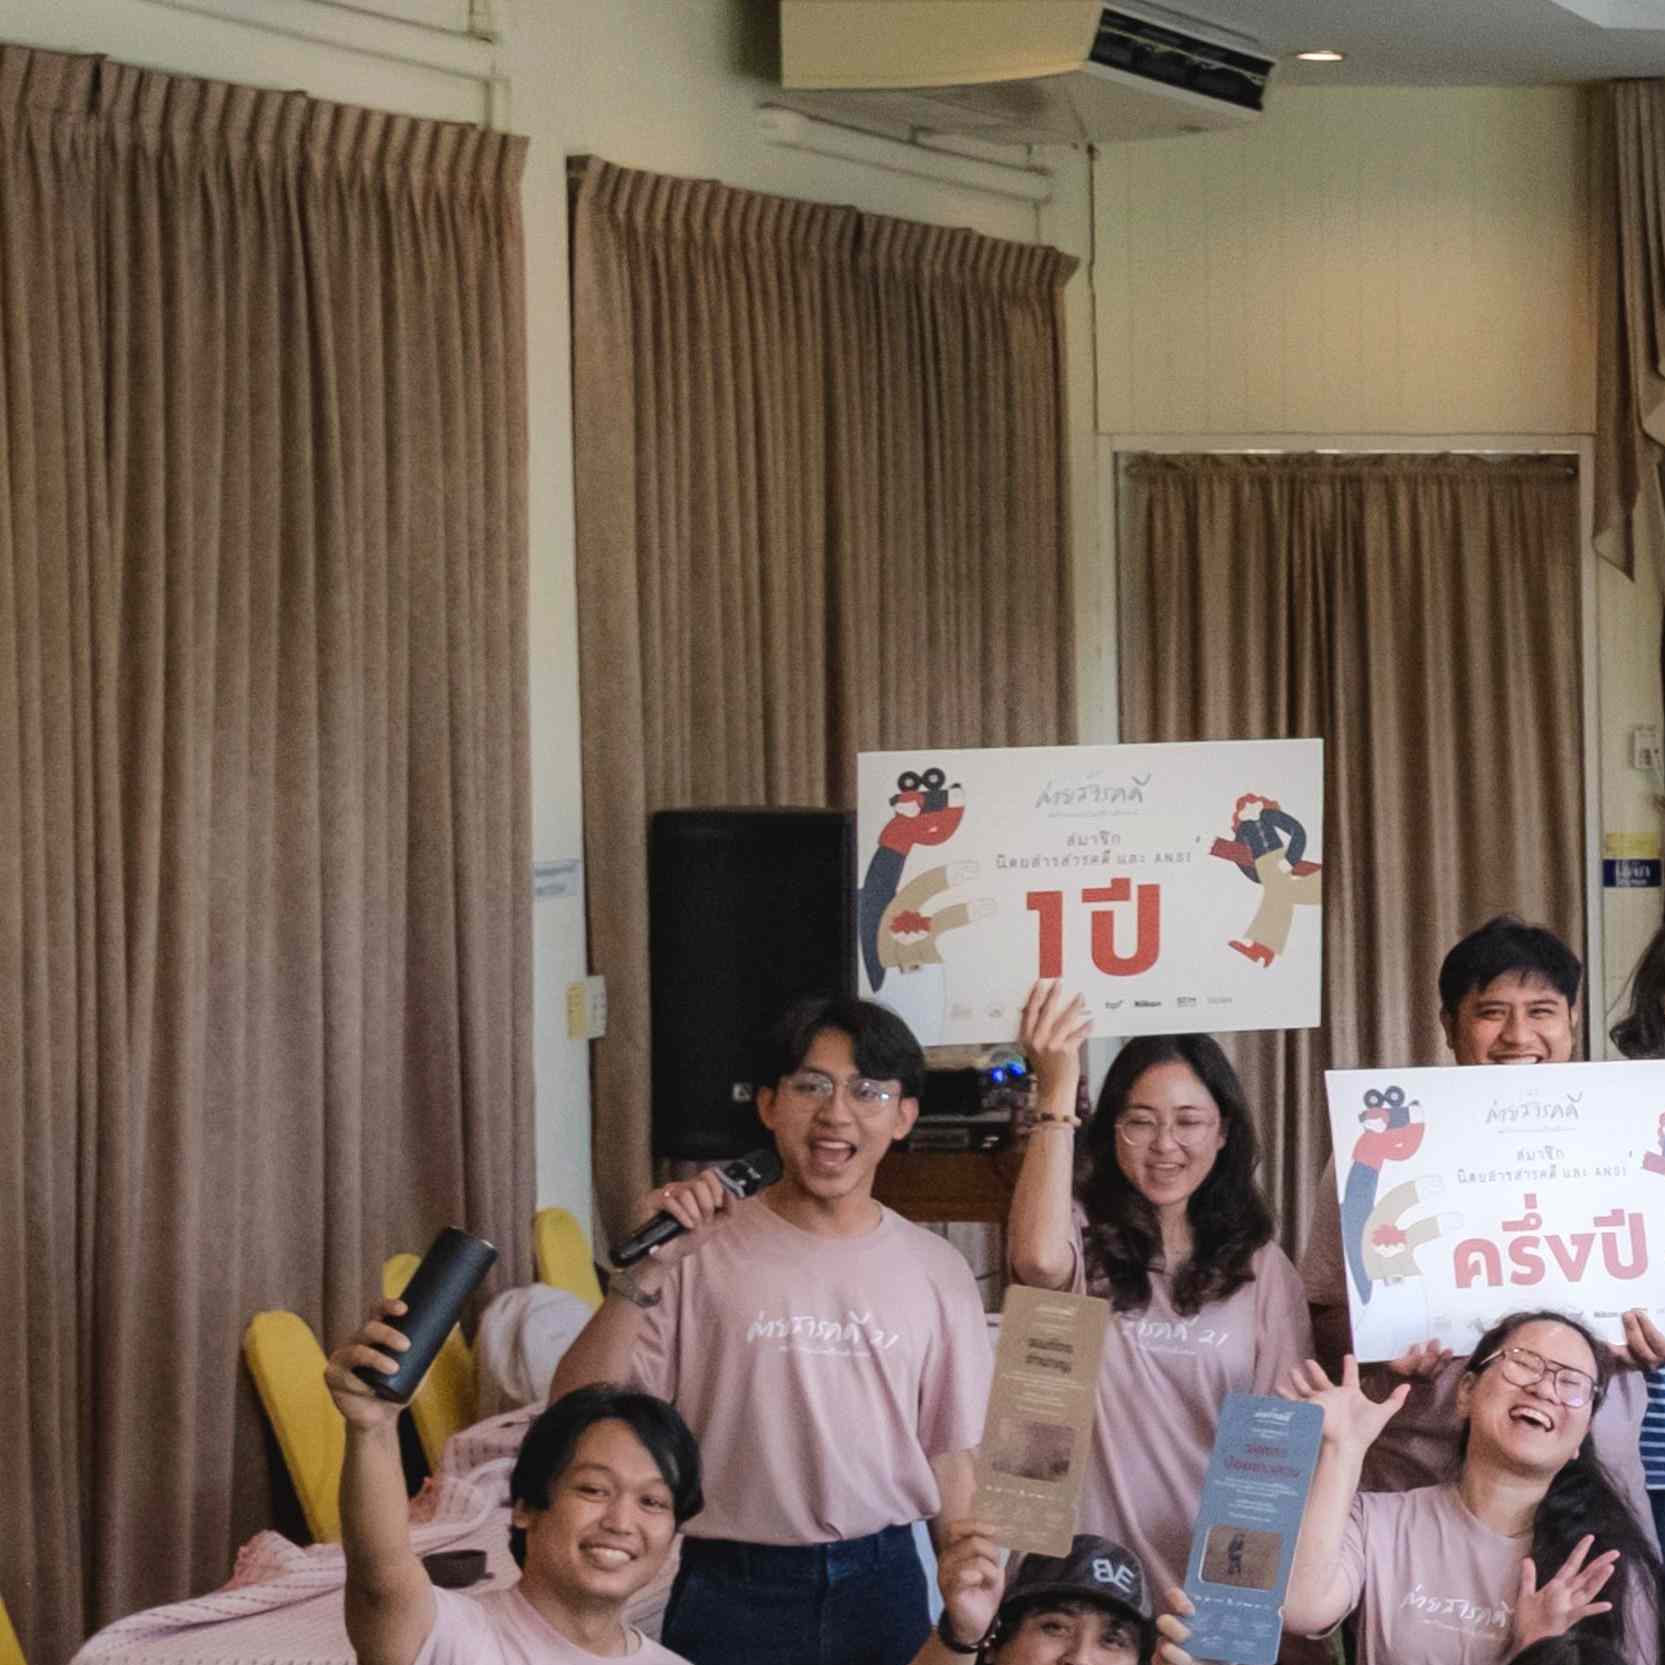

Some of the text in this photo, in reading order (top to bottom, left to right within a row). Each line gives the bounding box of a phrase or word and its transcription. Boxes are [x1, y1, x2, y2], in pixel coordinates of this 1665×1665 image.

[1453, 1192, 1649, 1289] ครึ่งปี
[874, 1328, 902, 1351] 21
[1202, 1327, 1229, 1347] 21
